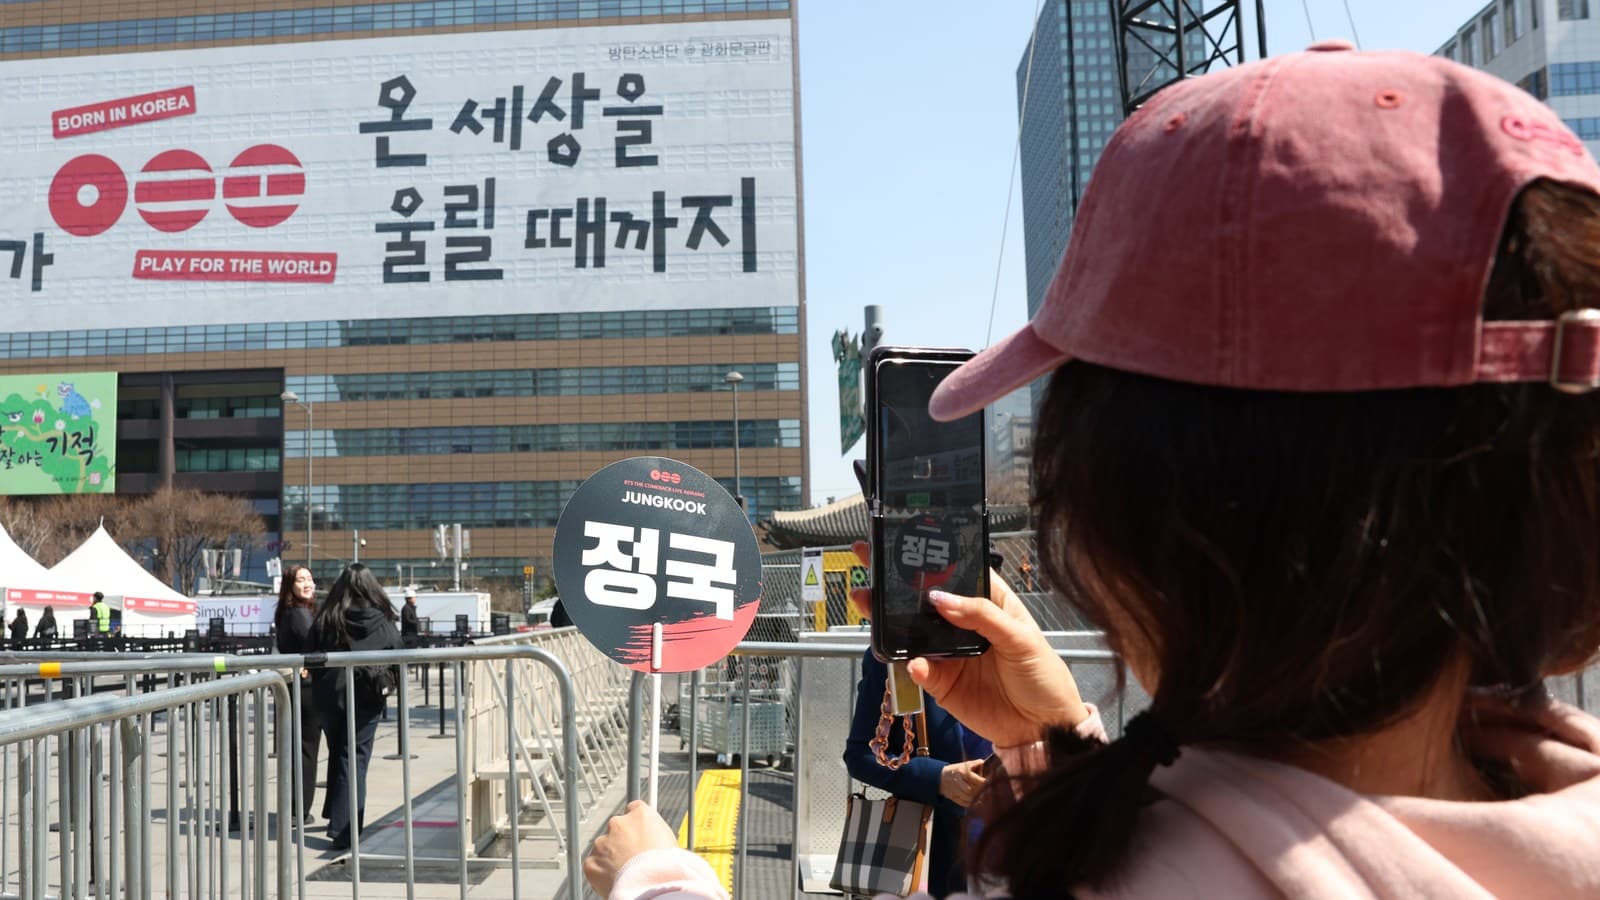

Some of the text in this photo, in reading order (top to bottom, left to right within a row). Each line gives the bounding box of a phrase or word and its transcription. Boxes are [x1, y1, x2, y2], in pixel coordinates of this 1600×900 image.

[608, 44, 678, 61] 방탄소년단
[58, 94, 191, 132] BORN IN KOREA
[359, 72, 664, 168] 온 세상을
[375, 177, 758, 283] 울릴 때까지
[140, 256, 332, 275] PLAY FOR THE WORLD
[46, 426, 95, 466] 기적
[622, 491, 706, 515] JUNGKOOK
[581, 520, 737, 621] 정국
[902, 535, 950, 572] 정국
[240, 604, 261, 618] U+
